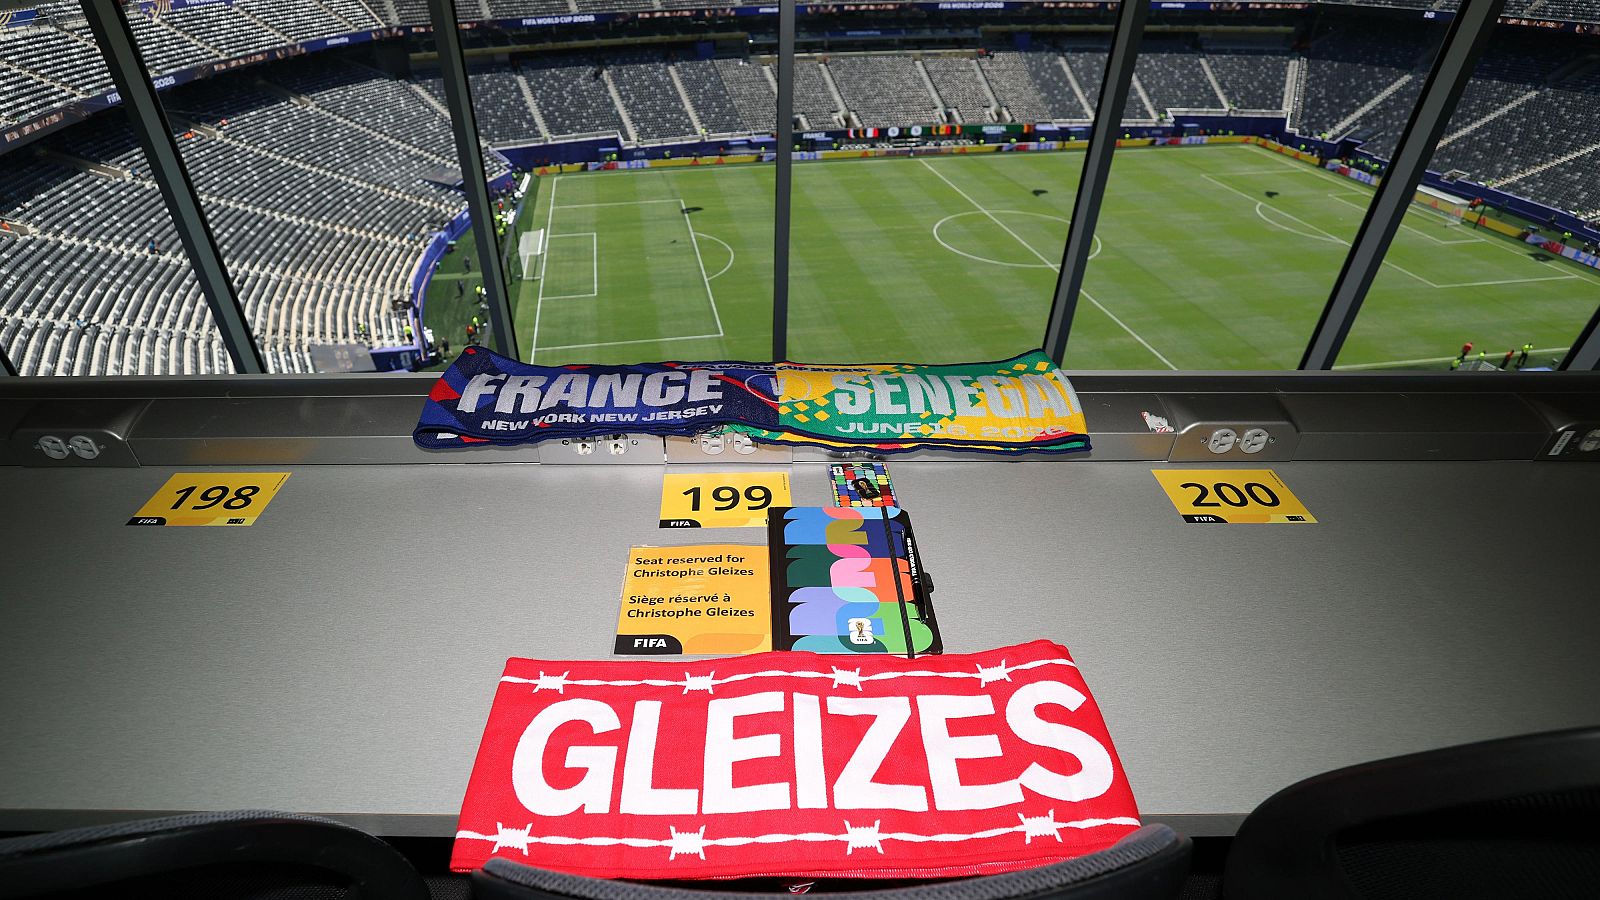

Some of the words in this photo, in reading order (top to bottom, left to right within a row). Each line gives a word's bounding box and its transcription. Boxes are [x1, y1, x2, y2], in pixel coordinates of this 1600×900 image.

[521, 18, 537, 26] FIFA
[106, 92, 122, 104] FIFA
[153, 75, 176, 89] 2026
[456, 370, 725, 414] FRANCE
[481, 418, 530, 432] NEW
[532, 412, 588, 428] YORK
[590, 411, 639, 424] NEW
[641, 404, 724, 422] JERSEY
[835, 421, 922, 435] JUNE
[170, 485, 261, 510] 198
[681, 485, 773, 512] 199
[1179, 482, 1281, 508] 200
[635, 556, 664, 565] Seat
[666, 554, 723, 565] reserved
[726, 554, 746, 564] for
[633, 567, 704, 579] Christophe
[708, 566, 755, 577] Gleizes
[629, 594, 665, 606] Siège
[668, 592, 719, 604] réservé
[722, 592, 731, 603] à
[627, 607, 702, 619] Christophe
[706, 606, 755, 617] Gleizes
[633, 638, 668, 648] FIFA
[511, 679, 1115, 816] GLEIZES
